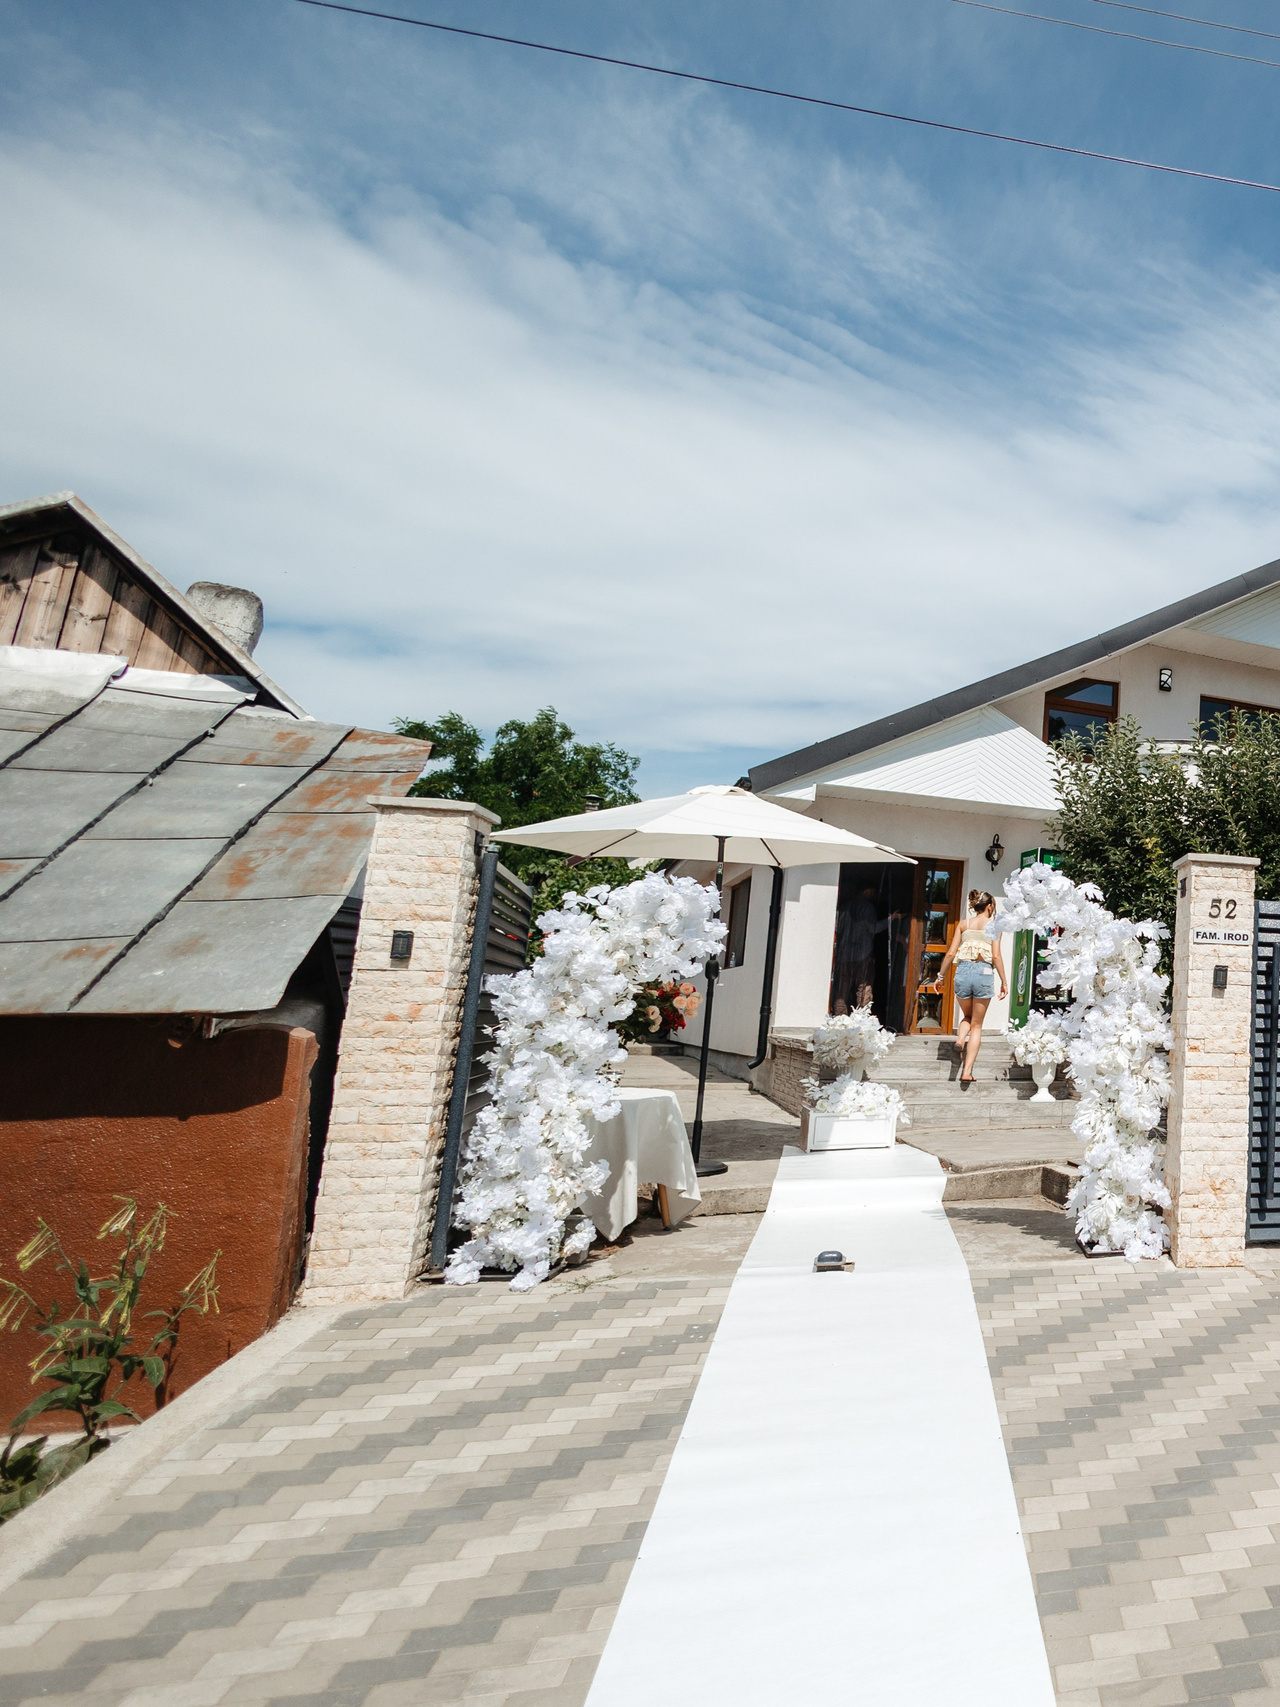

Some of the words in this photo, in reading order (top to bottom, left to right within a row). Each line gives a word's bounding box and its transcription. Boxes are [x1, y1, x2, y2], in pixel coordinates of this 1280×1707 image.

[1208, 898, 1237, 920] 52
[1195, 931, 1220, 940] FAM.
[1223, 932, 1249, 941] IROD
